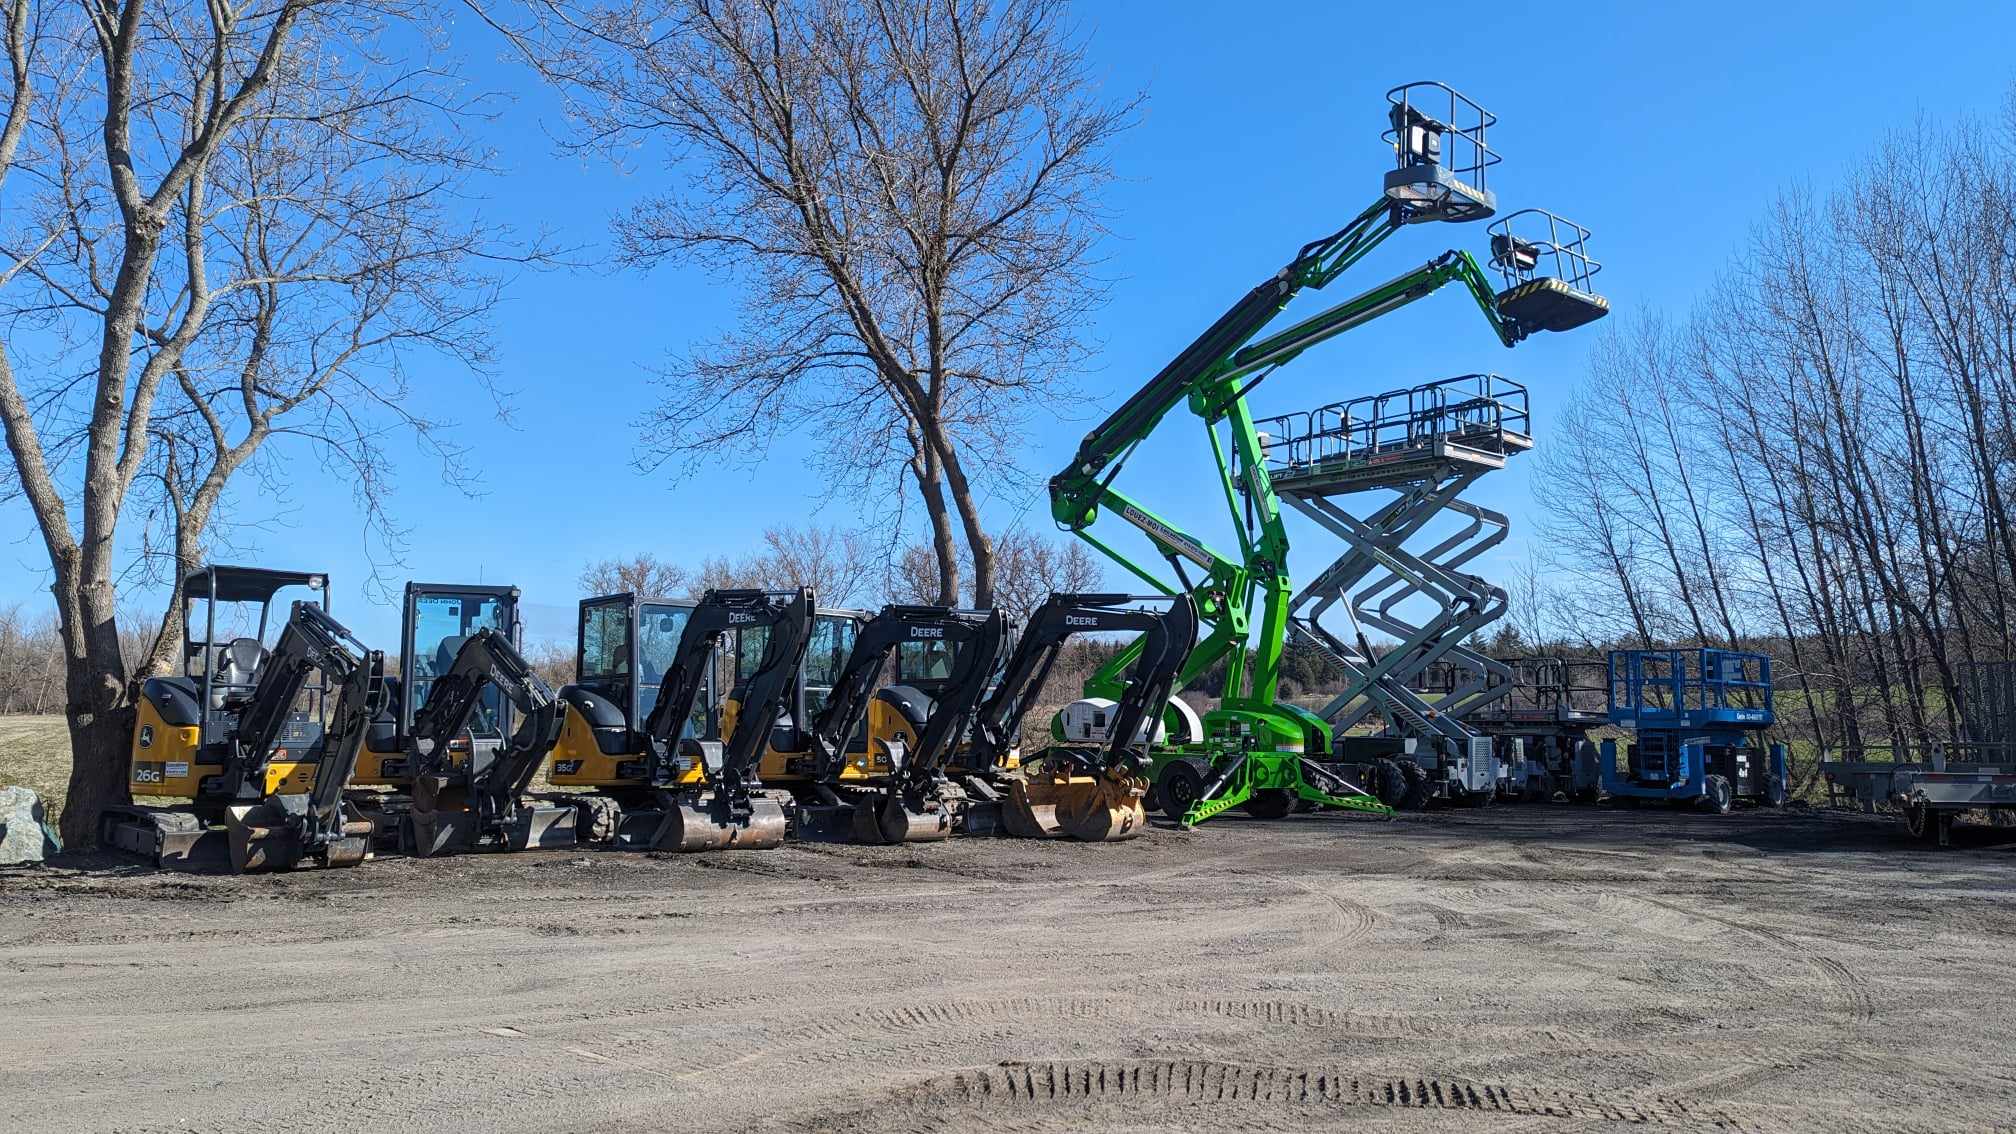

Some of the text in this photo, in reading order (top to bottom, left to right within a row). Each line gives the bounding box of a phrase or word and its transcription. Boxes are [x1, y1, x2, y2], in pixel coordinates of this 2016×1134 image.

[1066, 615, 1098, 626] DEERE
[911, 626, 944, 638] DEERE
[136, 769, 160, 782] 26G
